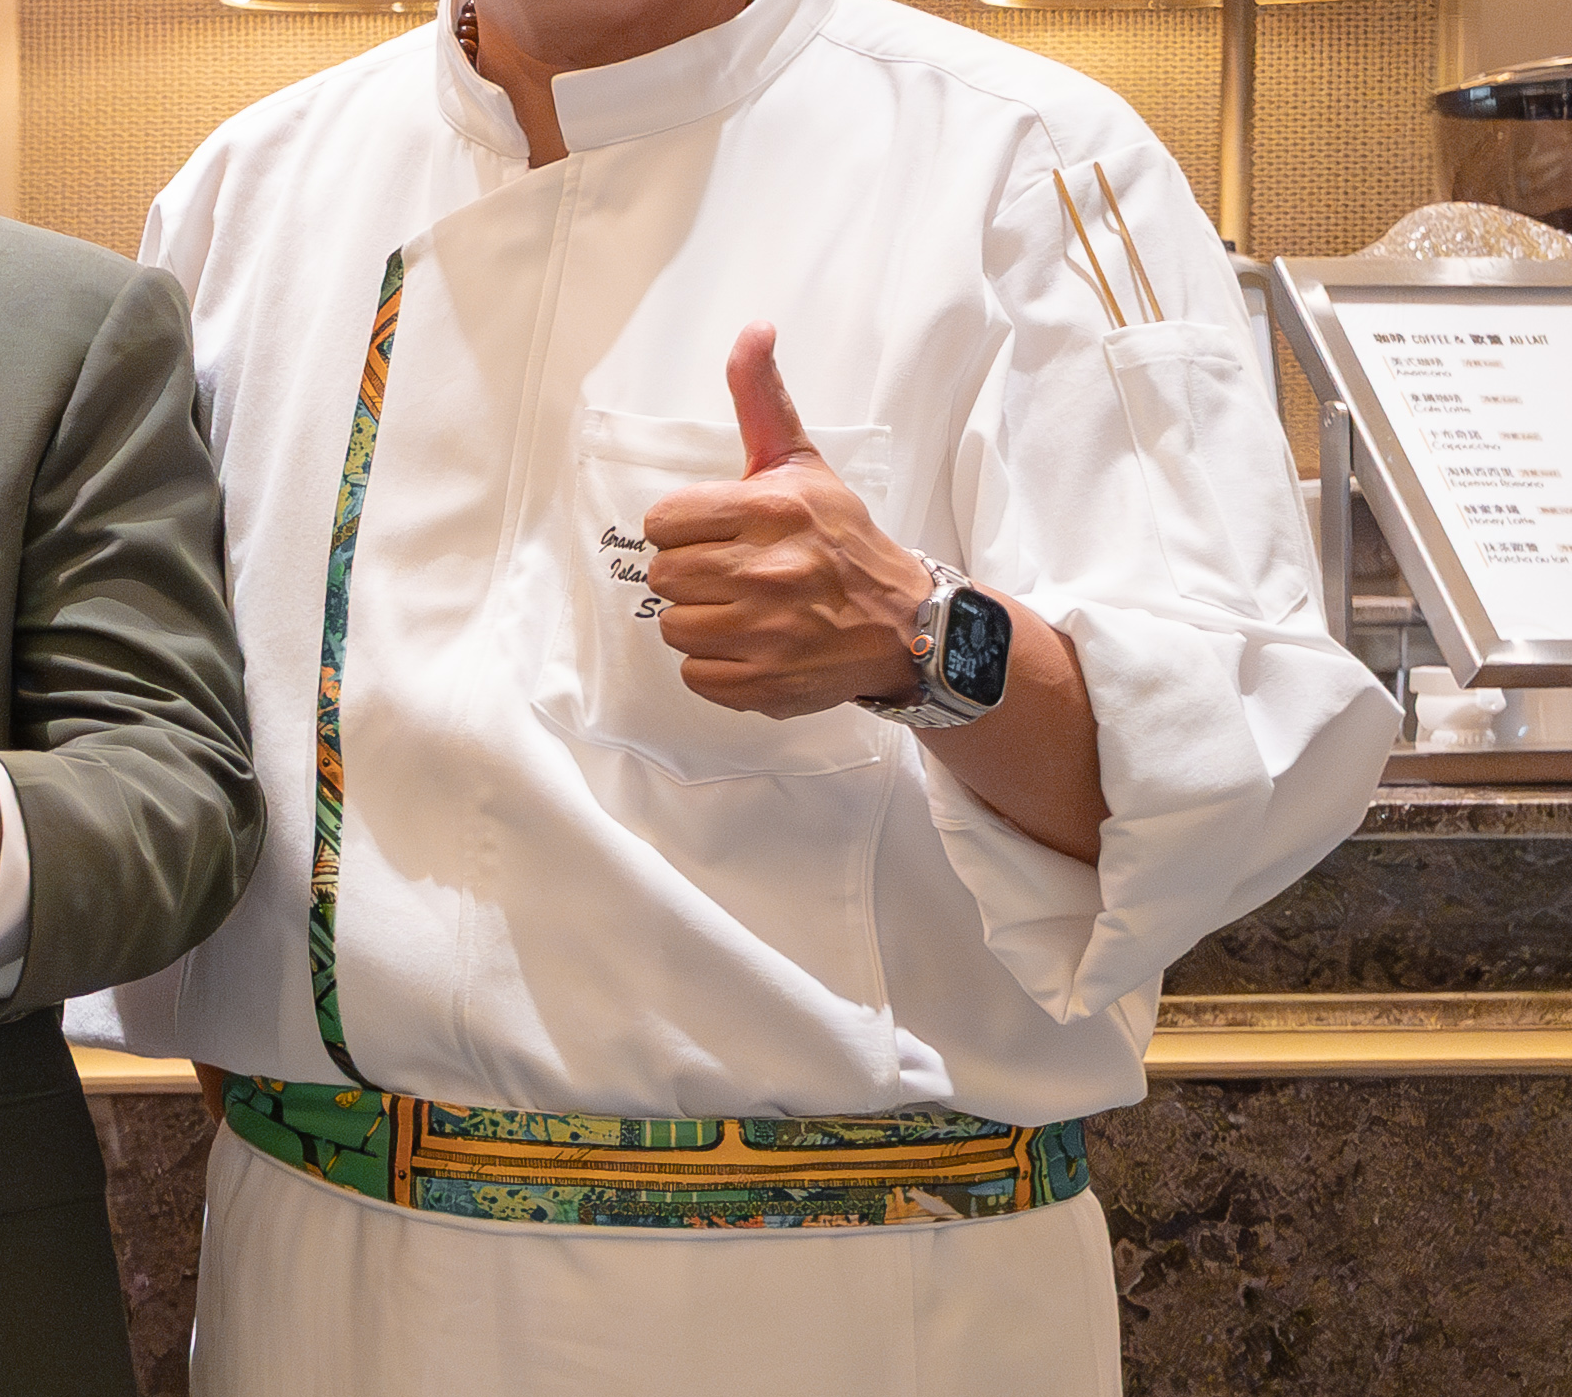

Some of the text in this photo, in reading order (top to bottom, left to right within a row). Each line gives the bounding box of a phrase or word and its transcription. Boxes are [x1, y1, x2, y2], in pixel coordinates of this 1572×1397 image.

[1373, 333, 1406, 345] 咖啡
[1411, 334, 1451, 345] COFFEE
[1509, 335, 1525, 345] AU
[1527, 334, 1550, 345] LAIT
[598, 526, 646, 553] Grand
